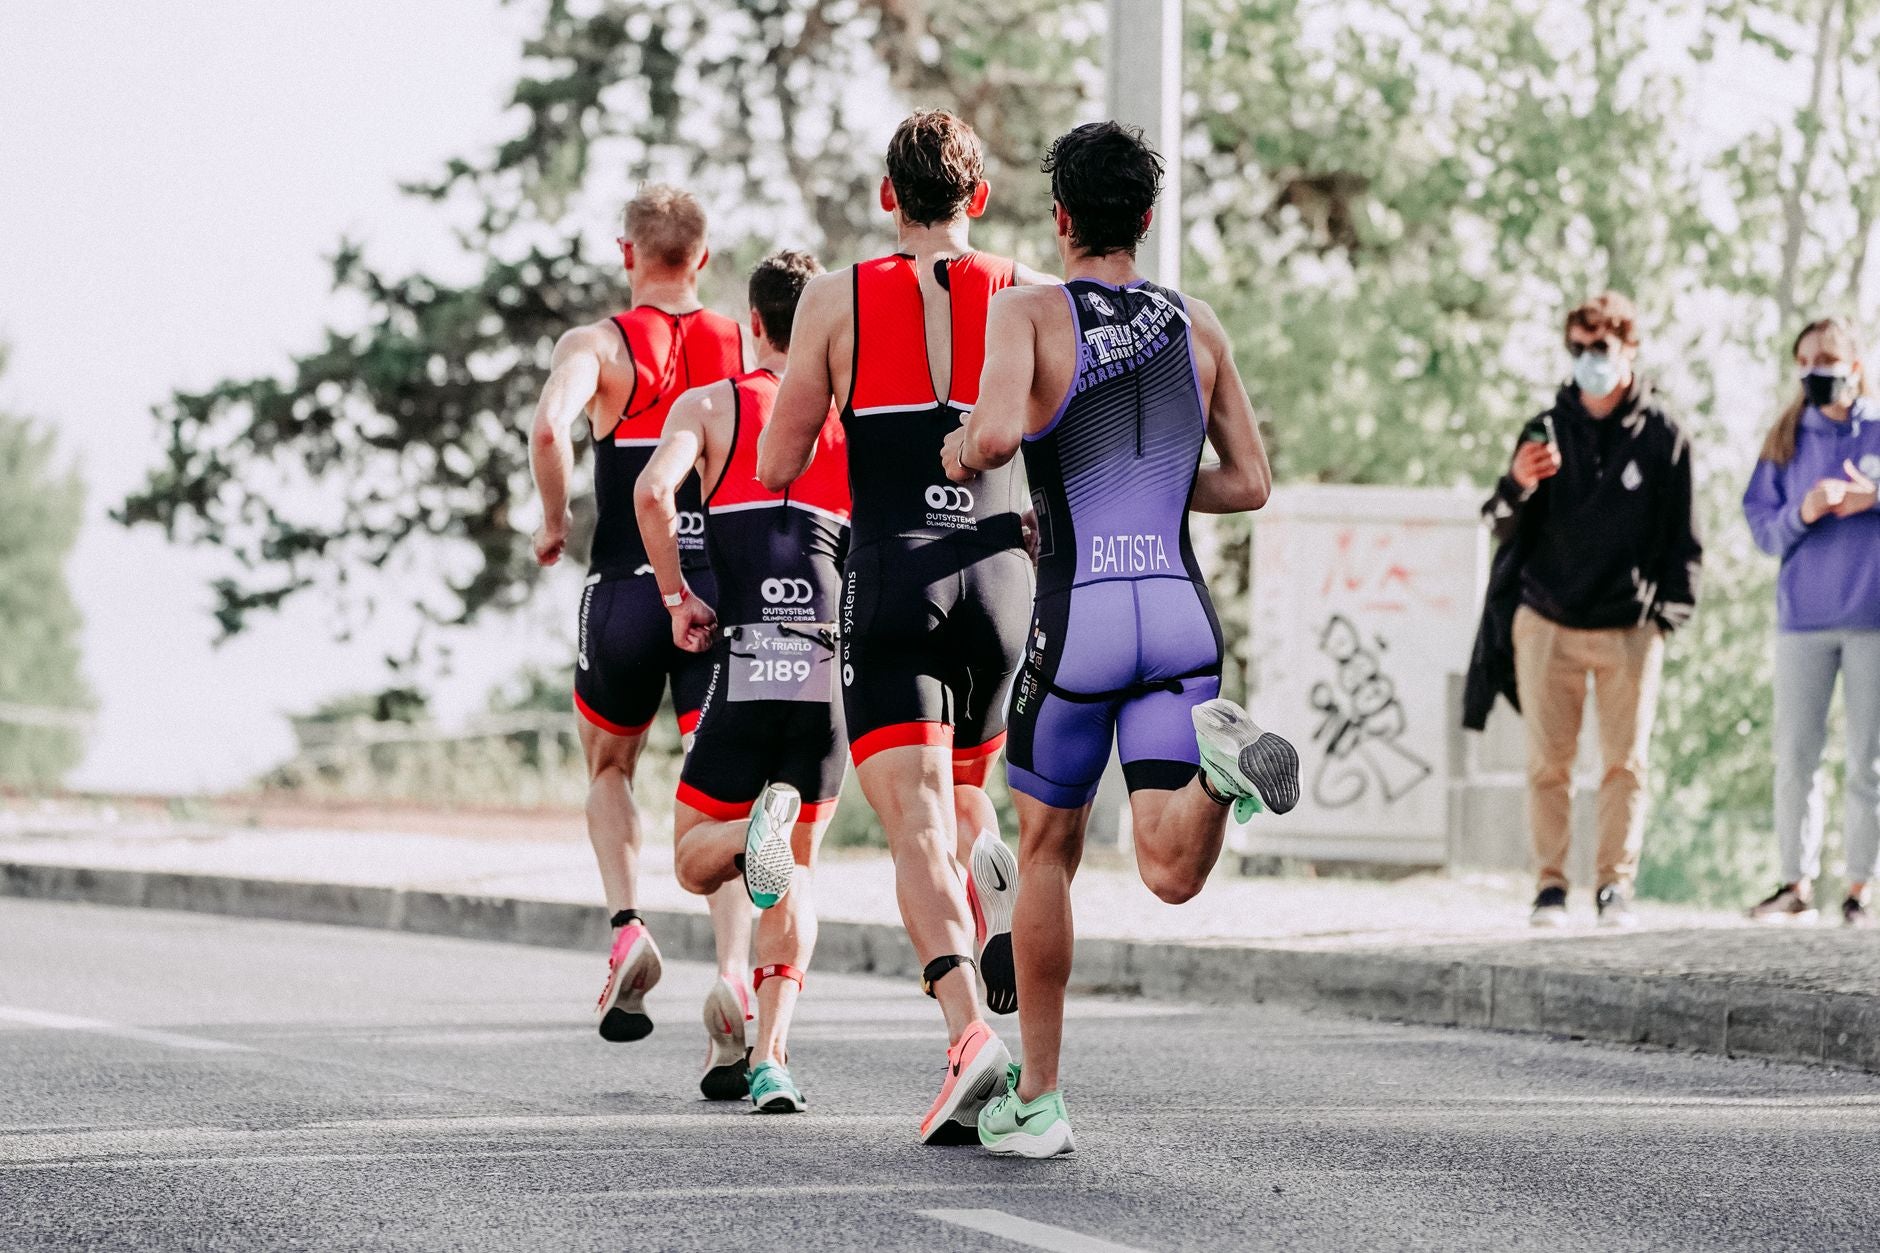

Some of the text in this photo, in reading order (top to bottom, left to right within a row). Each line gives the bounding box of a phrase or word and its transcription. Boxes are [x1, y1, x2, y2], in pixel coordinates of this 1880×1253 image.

[1144, 305, 1175, 343] NOVAS
[1074, 362, 1125, 395] ORRES
[1128, 332, 1170, 370] NOVAS
[926, 512, 977, 525] OUTSYSTEMS
[677, 536, 704, 545] YSTEMS
[1091, 534, 1170, 573] BATISTA
[762, 607, 815, 615] OUTSYSTEMS
[843, 571, 857, 660] ousystems
[771, 641, 812, 651] TRIATLO
[749, 659, 811, 682] 2189
[1016, 649, 1036, 715] FILSTE
[1029, 651, 1043, 700] natral
[695, 663, 721, 733] utsystems
